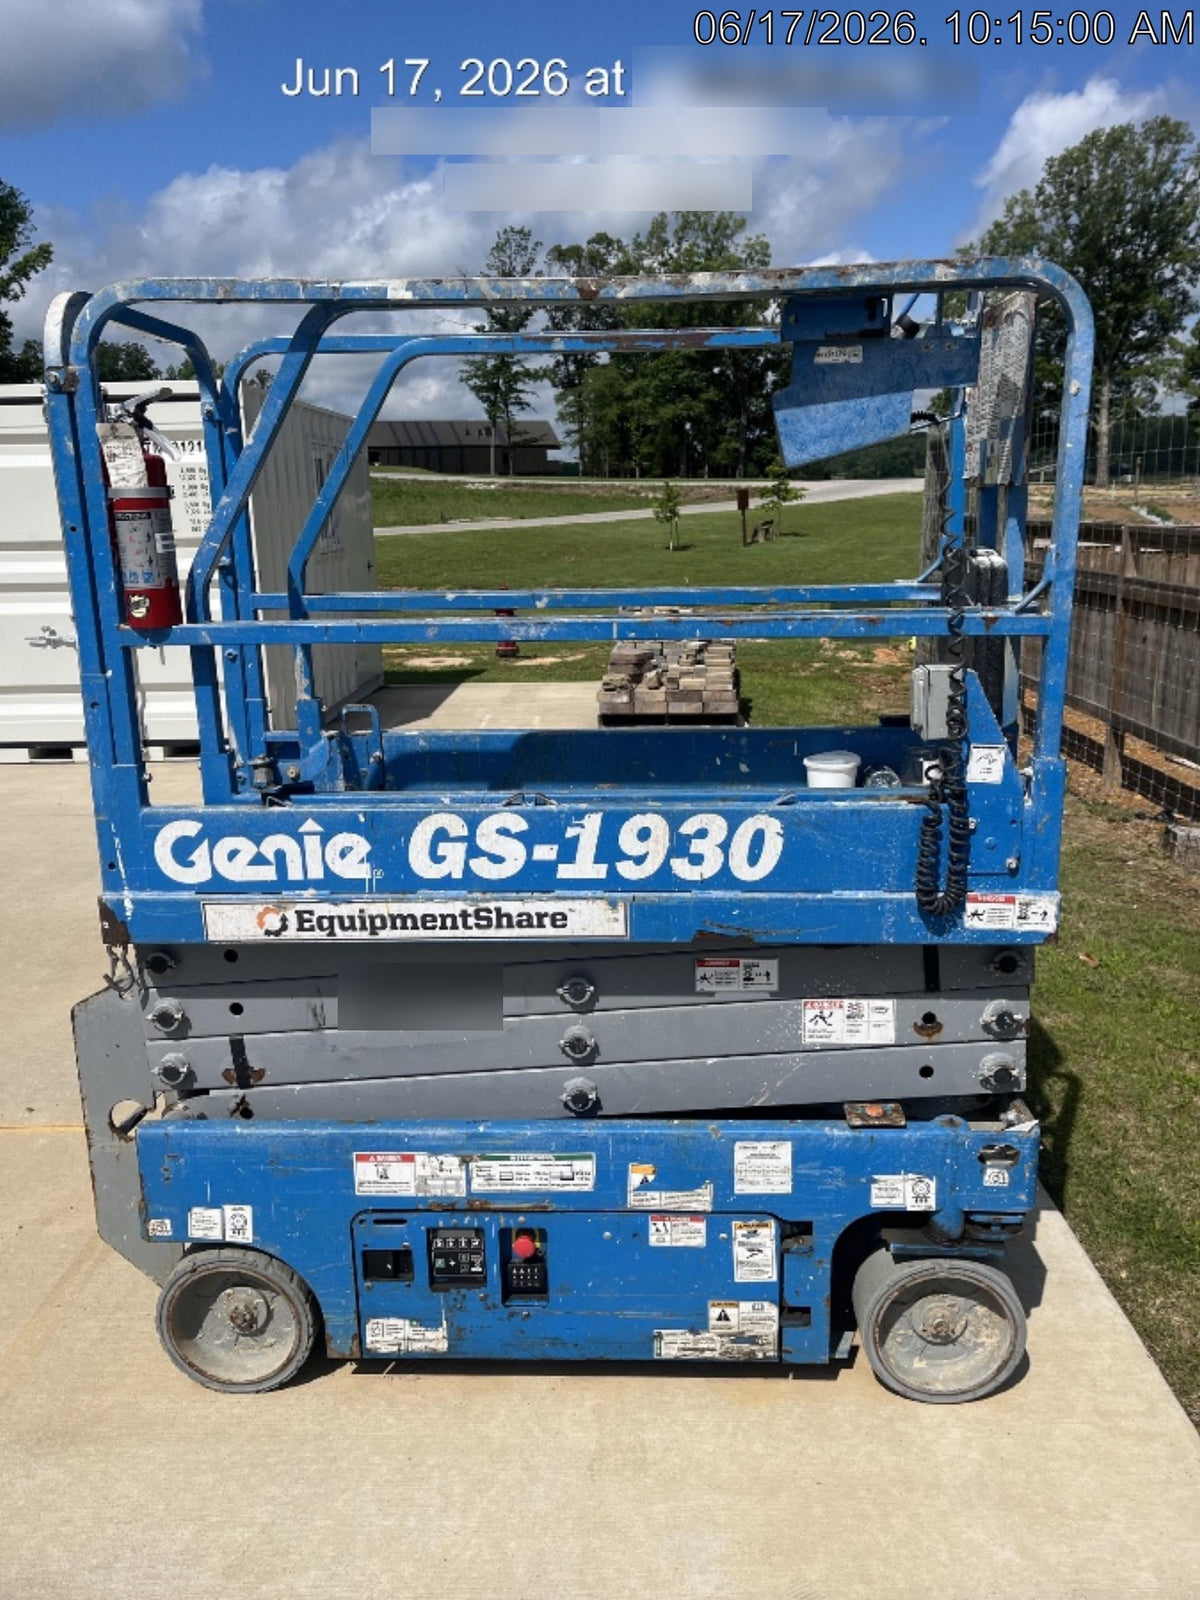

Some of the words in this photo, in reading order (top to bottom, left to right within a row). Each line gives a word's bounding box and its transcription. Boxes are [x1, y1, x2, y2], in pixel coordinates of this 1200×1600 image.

[153, 817, 373, 885] Genie
[408, 811, 784, 881] GS-1930
[295, 906, 568, 936] EquipmentShare
